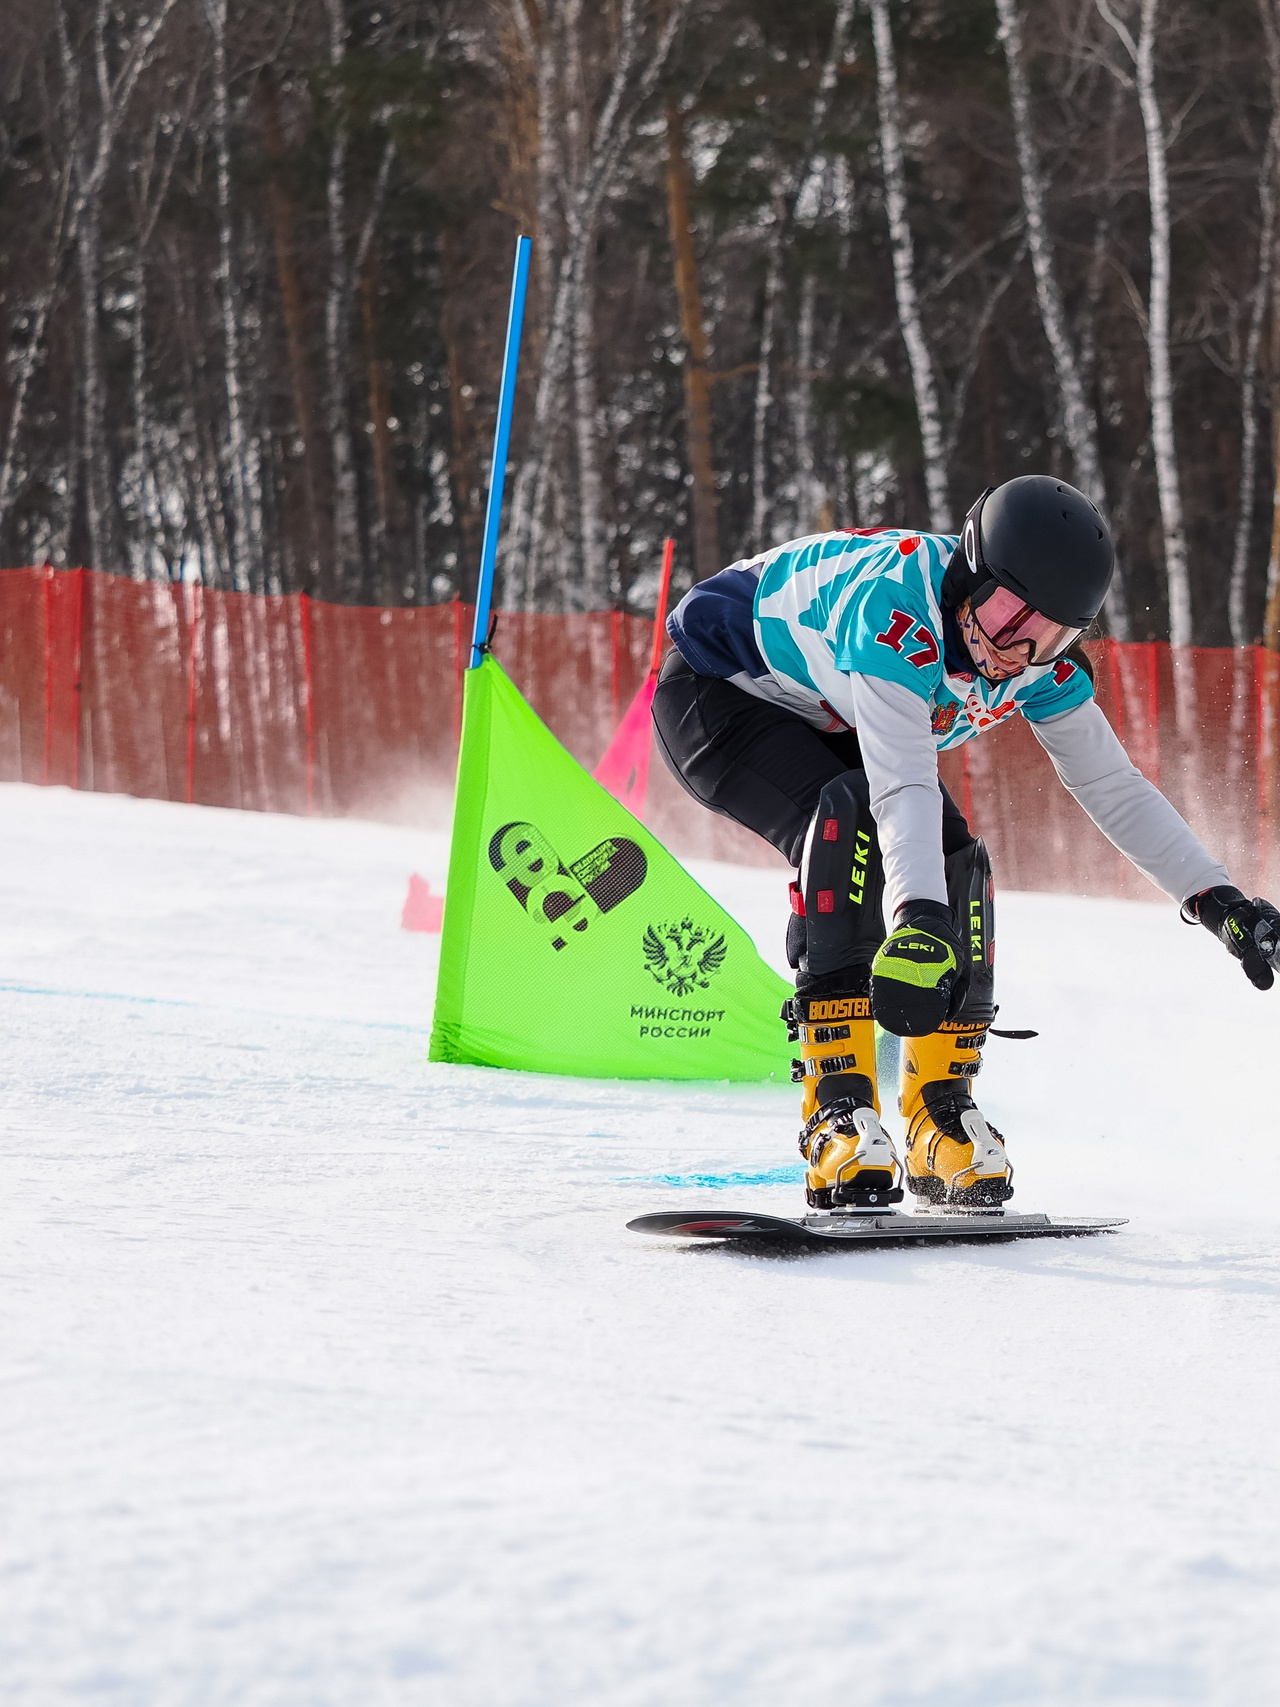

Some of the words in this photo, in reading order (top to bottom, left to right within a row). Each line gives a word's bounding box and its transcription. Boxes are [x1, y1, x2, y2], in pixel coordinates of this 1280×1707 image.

[876, 609, 939, 669] 17
[849, 829, 871, 905] LEKI
[969, 900, 983, 962] LEKI
[1228, 917, 1245, 941] LEKI
[897, 942, 935, 953] LEKI
[630, 1005, 726, 1022] МИНСПОРТ
[640, 1025, 711, 1038] РОССИИ
